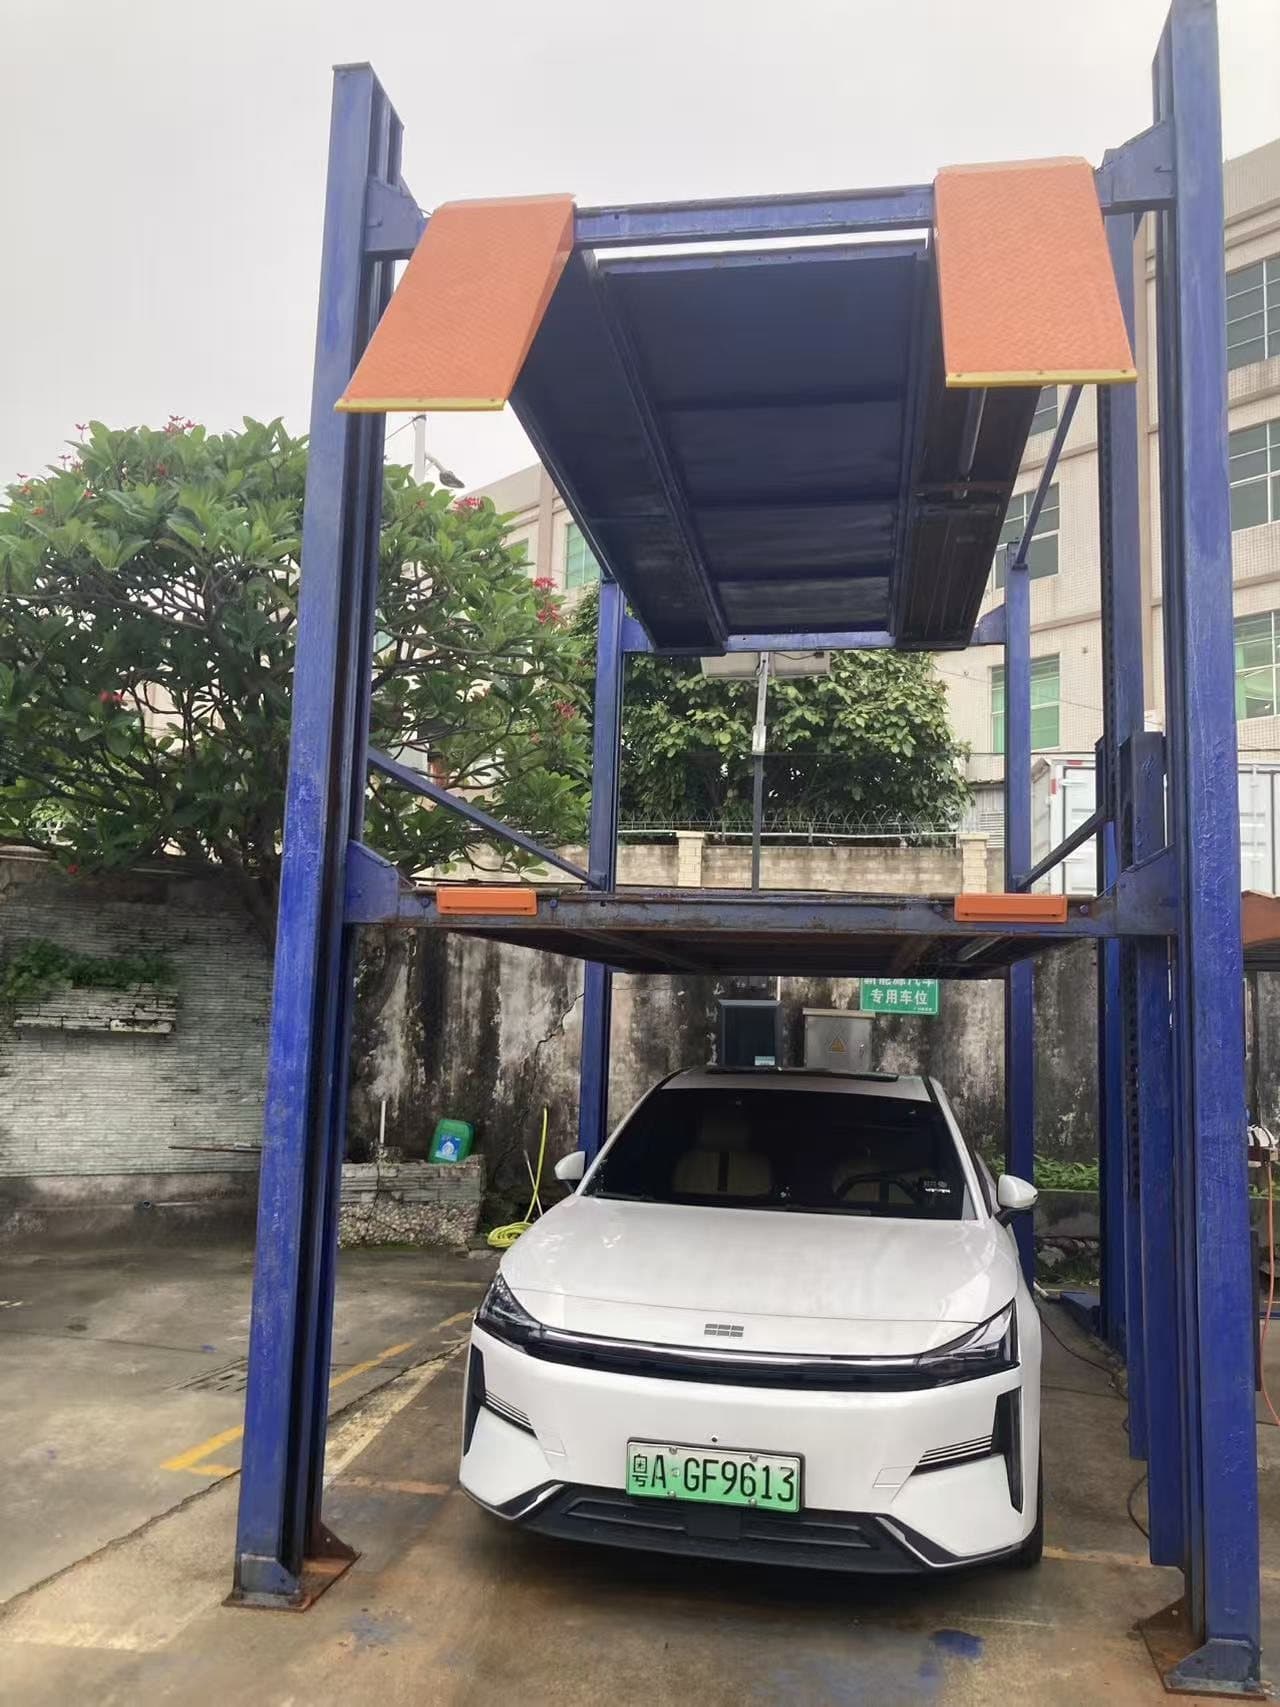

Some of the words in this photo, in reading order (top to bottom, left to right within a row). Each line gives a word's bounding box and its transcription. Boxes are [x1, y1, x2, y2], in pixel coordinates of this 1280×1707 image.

[870, 988, 928, 1005] 专用车位
[683, 1457, 795, 1503] GF9613
